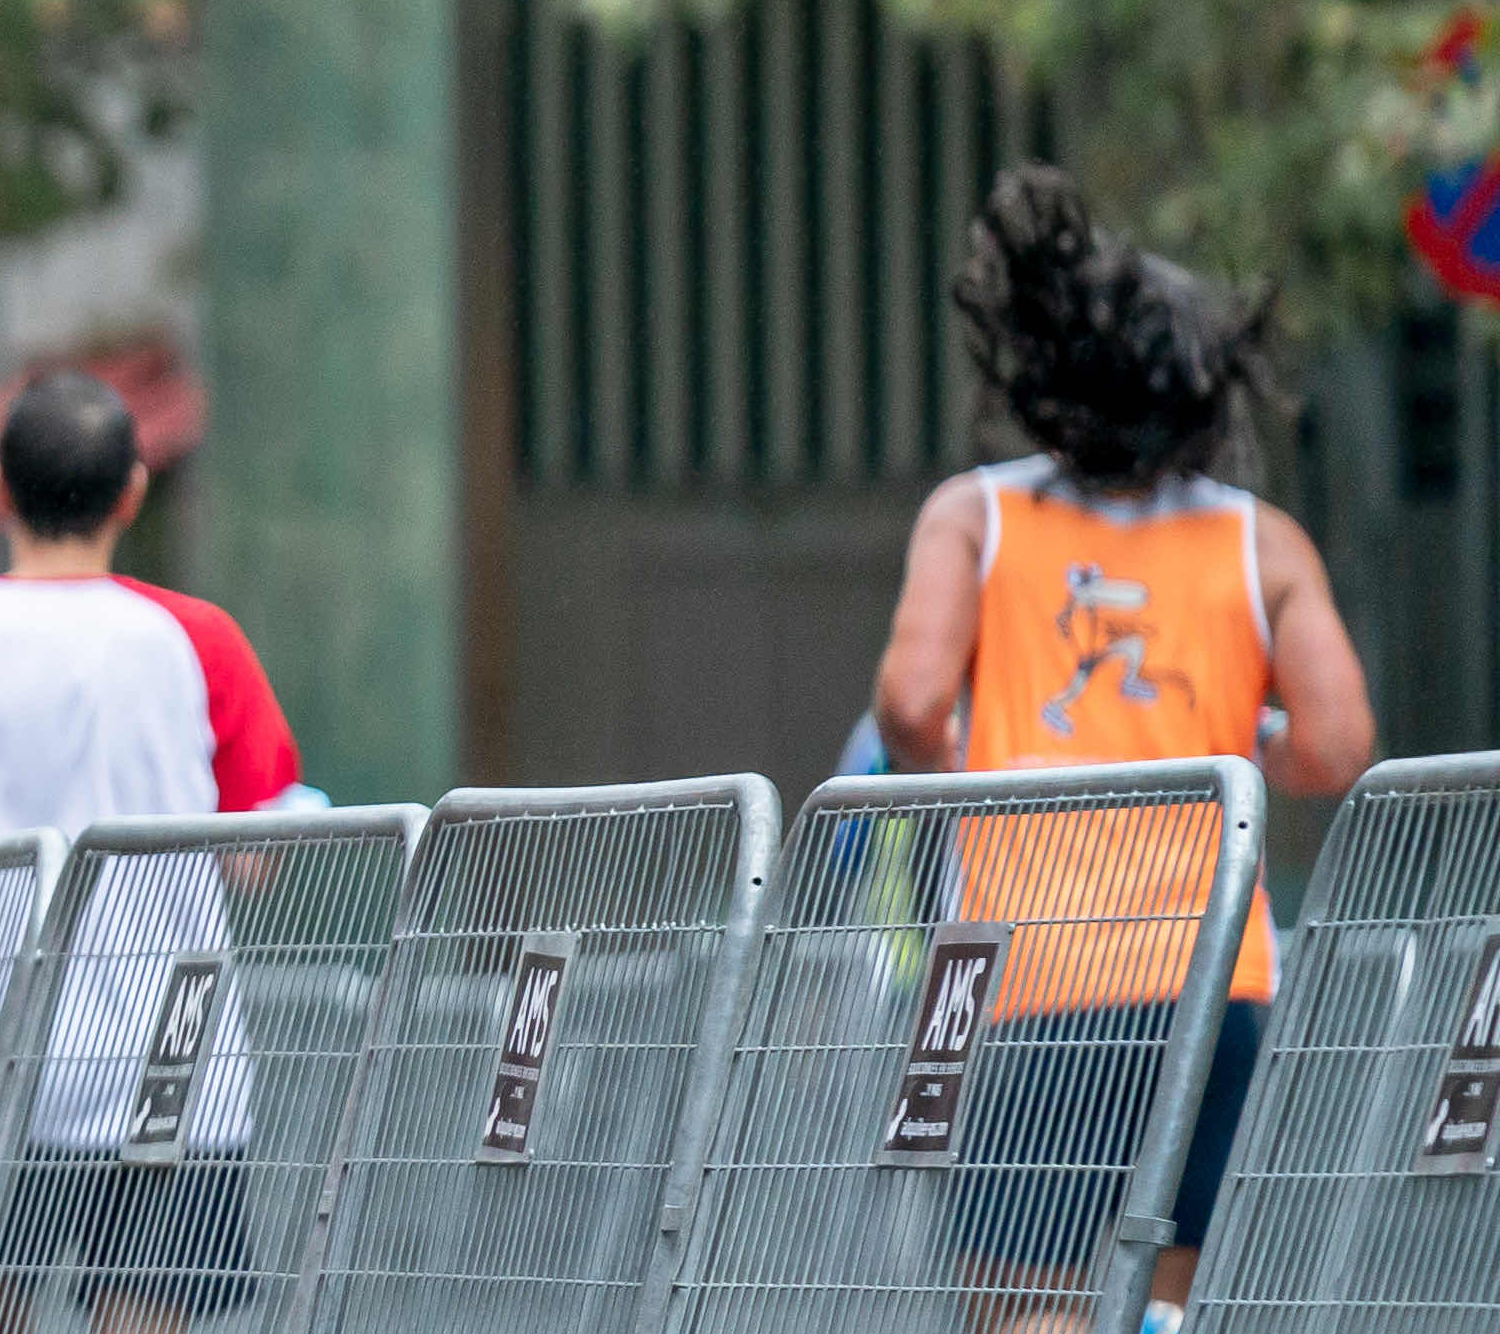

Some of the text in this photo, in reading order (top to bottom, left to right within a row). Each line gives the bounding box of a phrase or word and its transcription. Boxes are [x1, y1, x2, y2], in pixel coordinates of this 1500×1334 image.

[158, 973, 214, 1059] AMS
[508, 966, 559, 1058] AMS
[921, 957, 987, 1051] AMS
